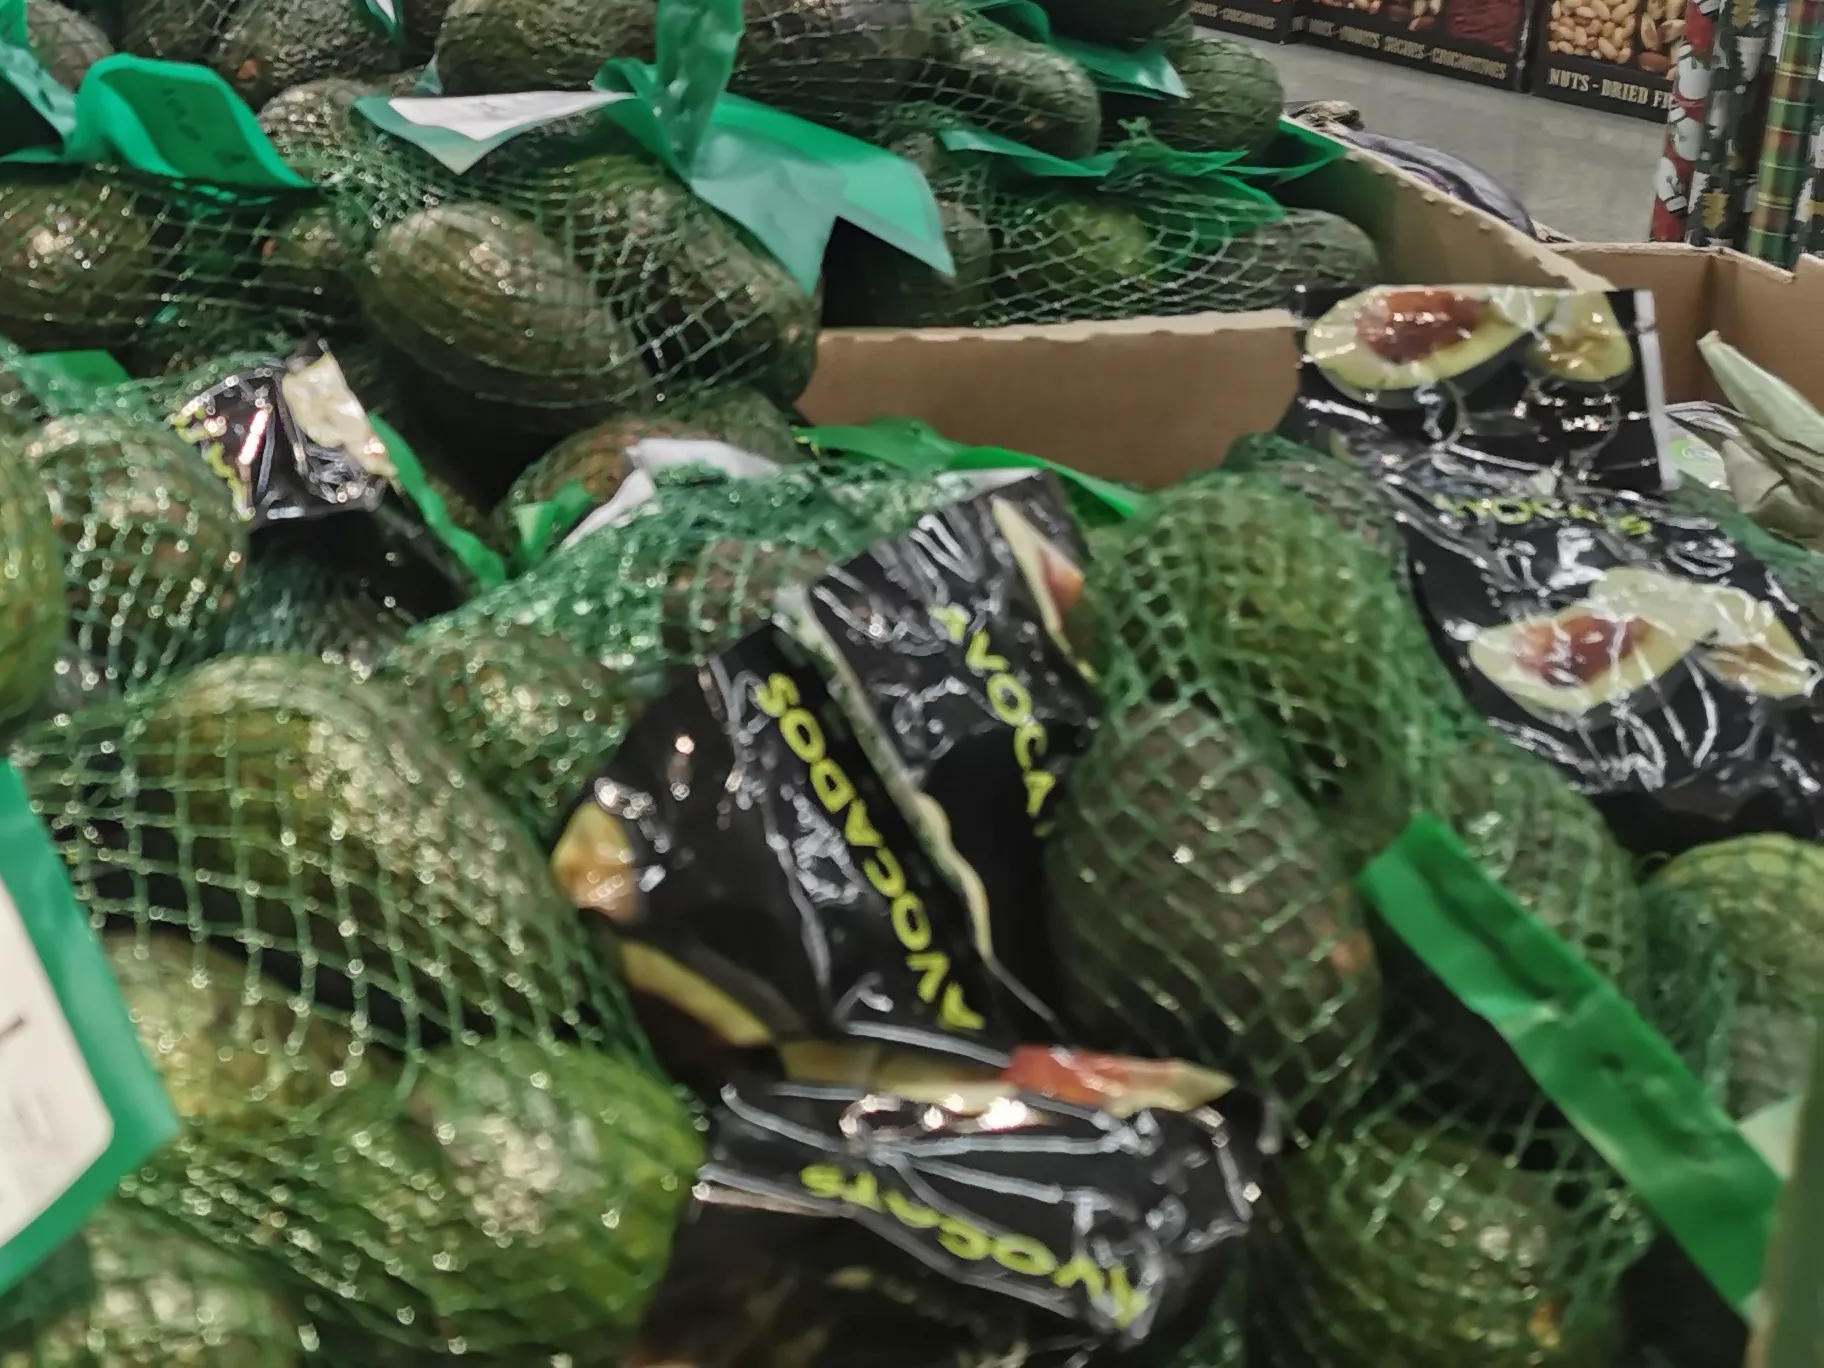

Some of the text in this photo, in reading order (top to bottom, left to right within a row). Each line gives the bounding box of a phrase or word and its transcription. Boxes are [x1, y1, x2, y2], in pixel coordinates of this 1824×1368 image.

[1549, 68, 1590, 92] NUTS
[1600, 78, 1649, 105] DRIED
[754, 672, 984, 1031] AVOCADOS
